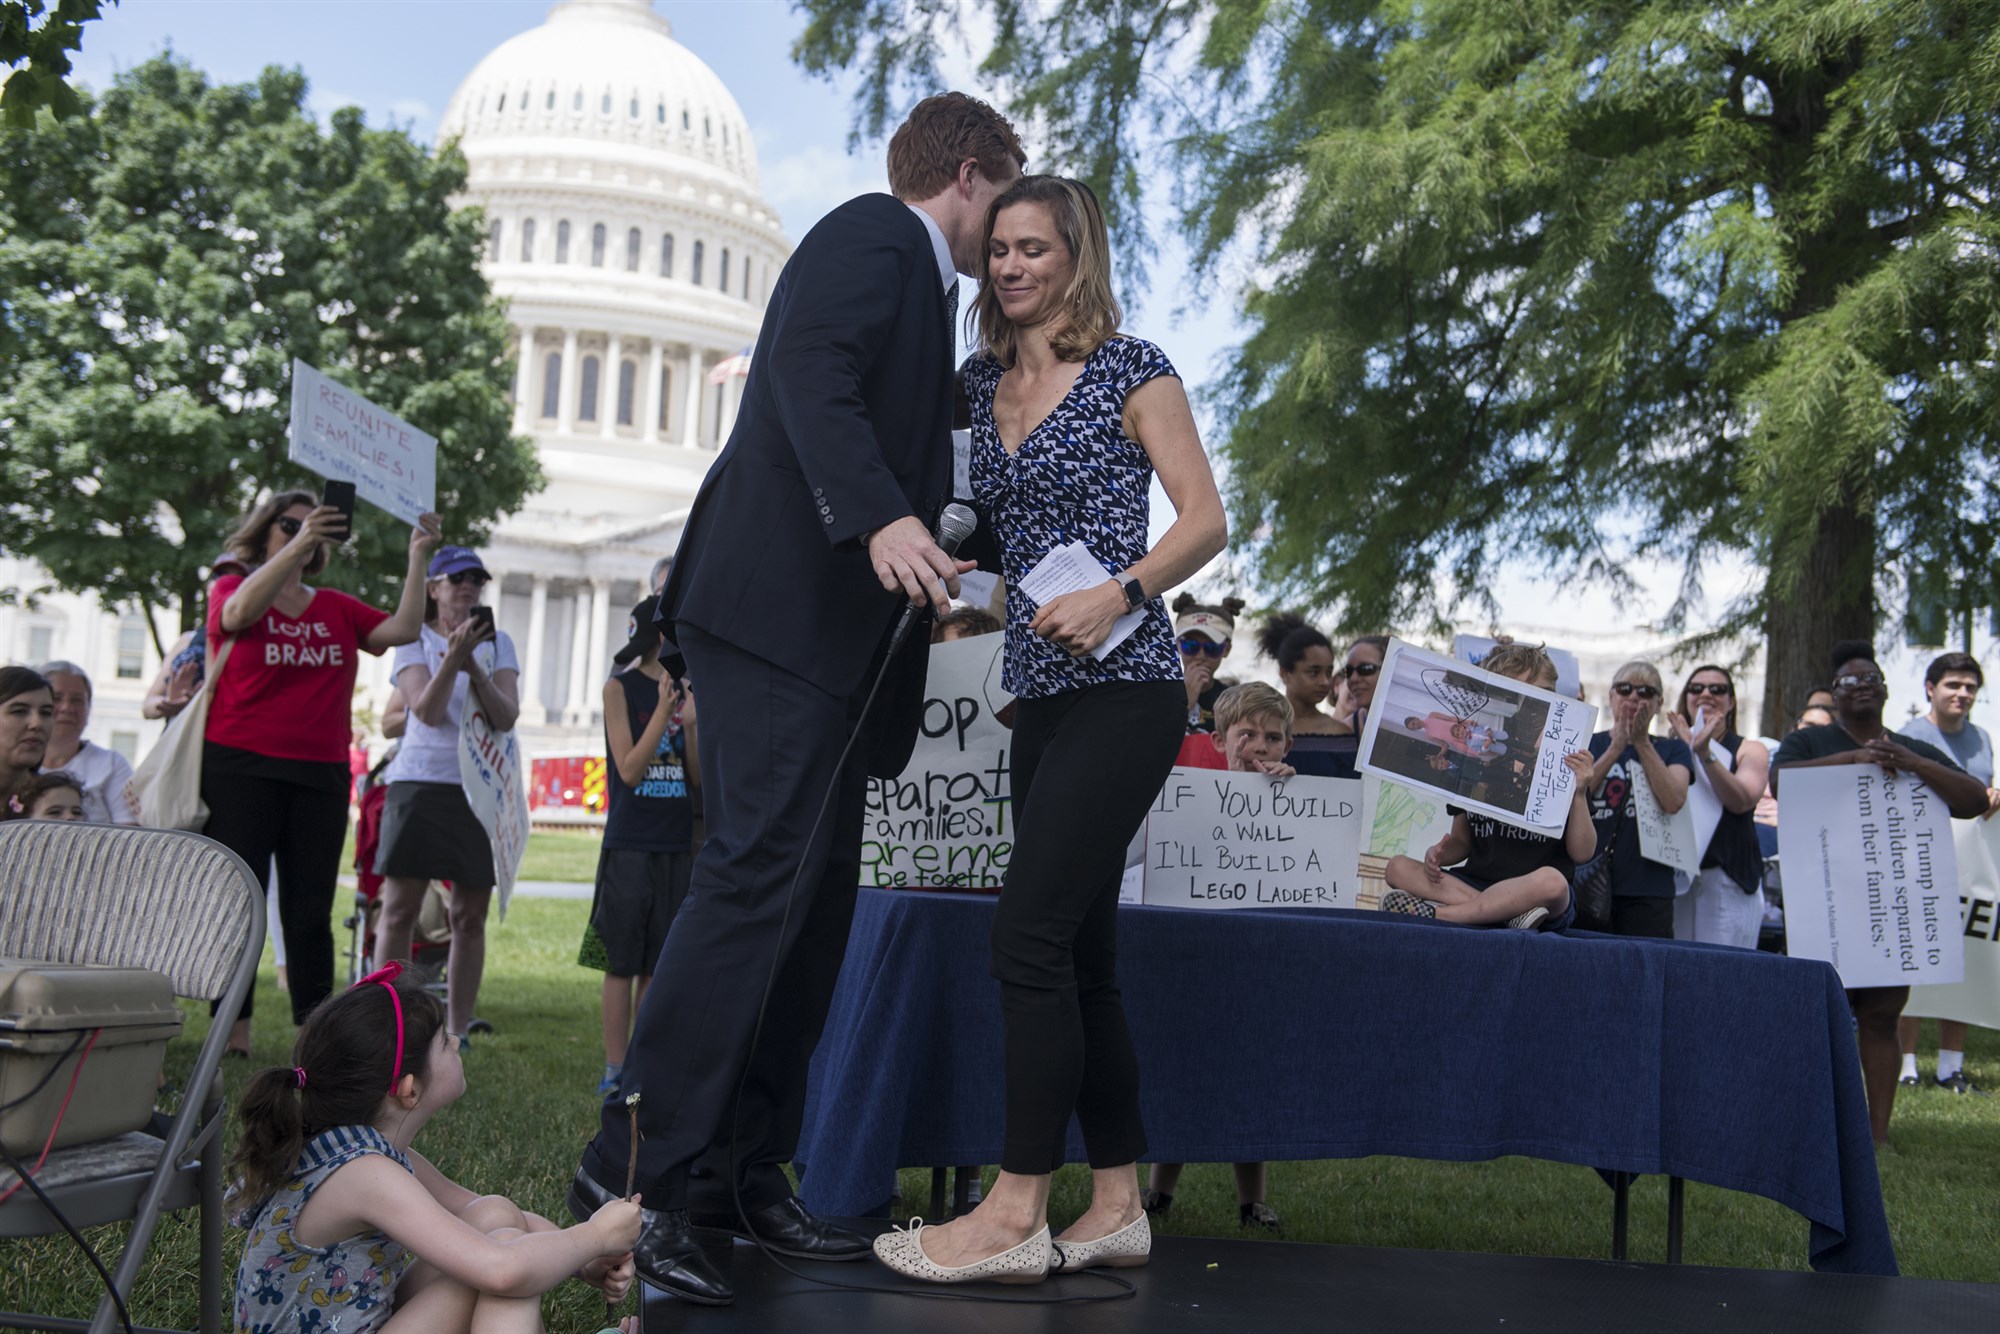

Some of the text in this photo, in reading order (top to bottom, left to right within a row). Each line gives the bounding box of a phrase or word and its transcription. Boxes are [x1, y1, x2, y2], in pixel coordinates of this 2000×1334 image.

[319, 383, 413, 453] REUNITE
[313, 414, 415, 485] FAMILIES!
[268, 615, 332, 640] LOVE
[265, 643, 344, 667] BRAVE
[920, 697, 979, 751] op
[865, 749, 1011, 817] eparat
[1525, 700, 1569, 824] FAMILIES BELONG
[1151, 773, 1354, 818] IF YOU BUILD
[1857, 774, 1875, 818] from
[1212, 821, 1295, 842] a WALL
[1656, 841, 1682, 863] VOTE
[1861, 821, 1882, 865] their
[1154, 841, 1322, 873] I'LL BUILD A
[1883, 774, 1920, 973] see children separated
[1909, 779, 1941, 966] Mrs. Trump hates to
[1190, 875, 1338, 903] LEGO LADDER!
